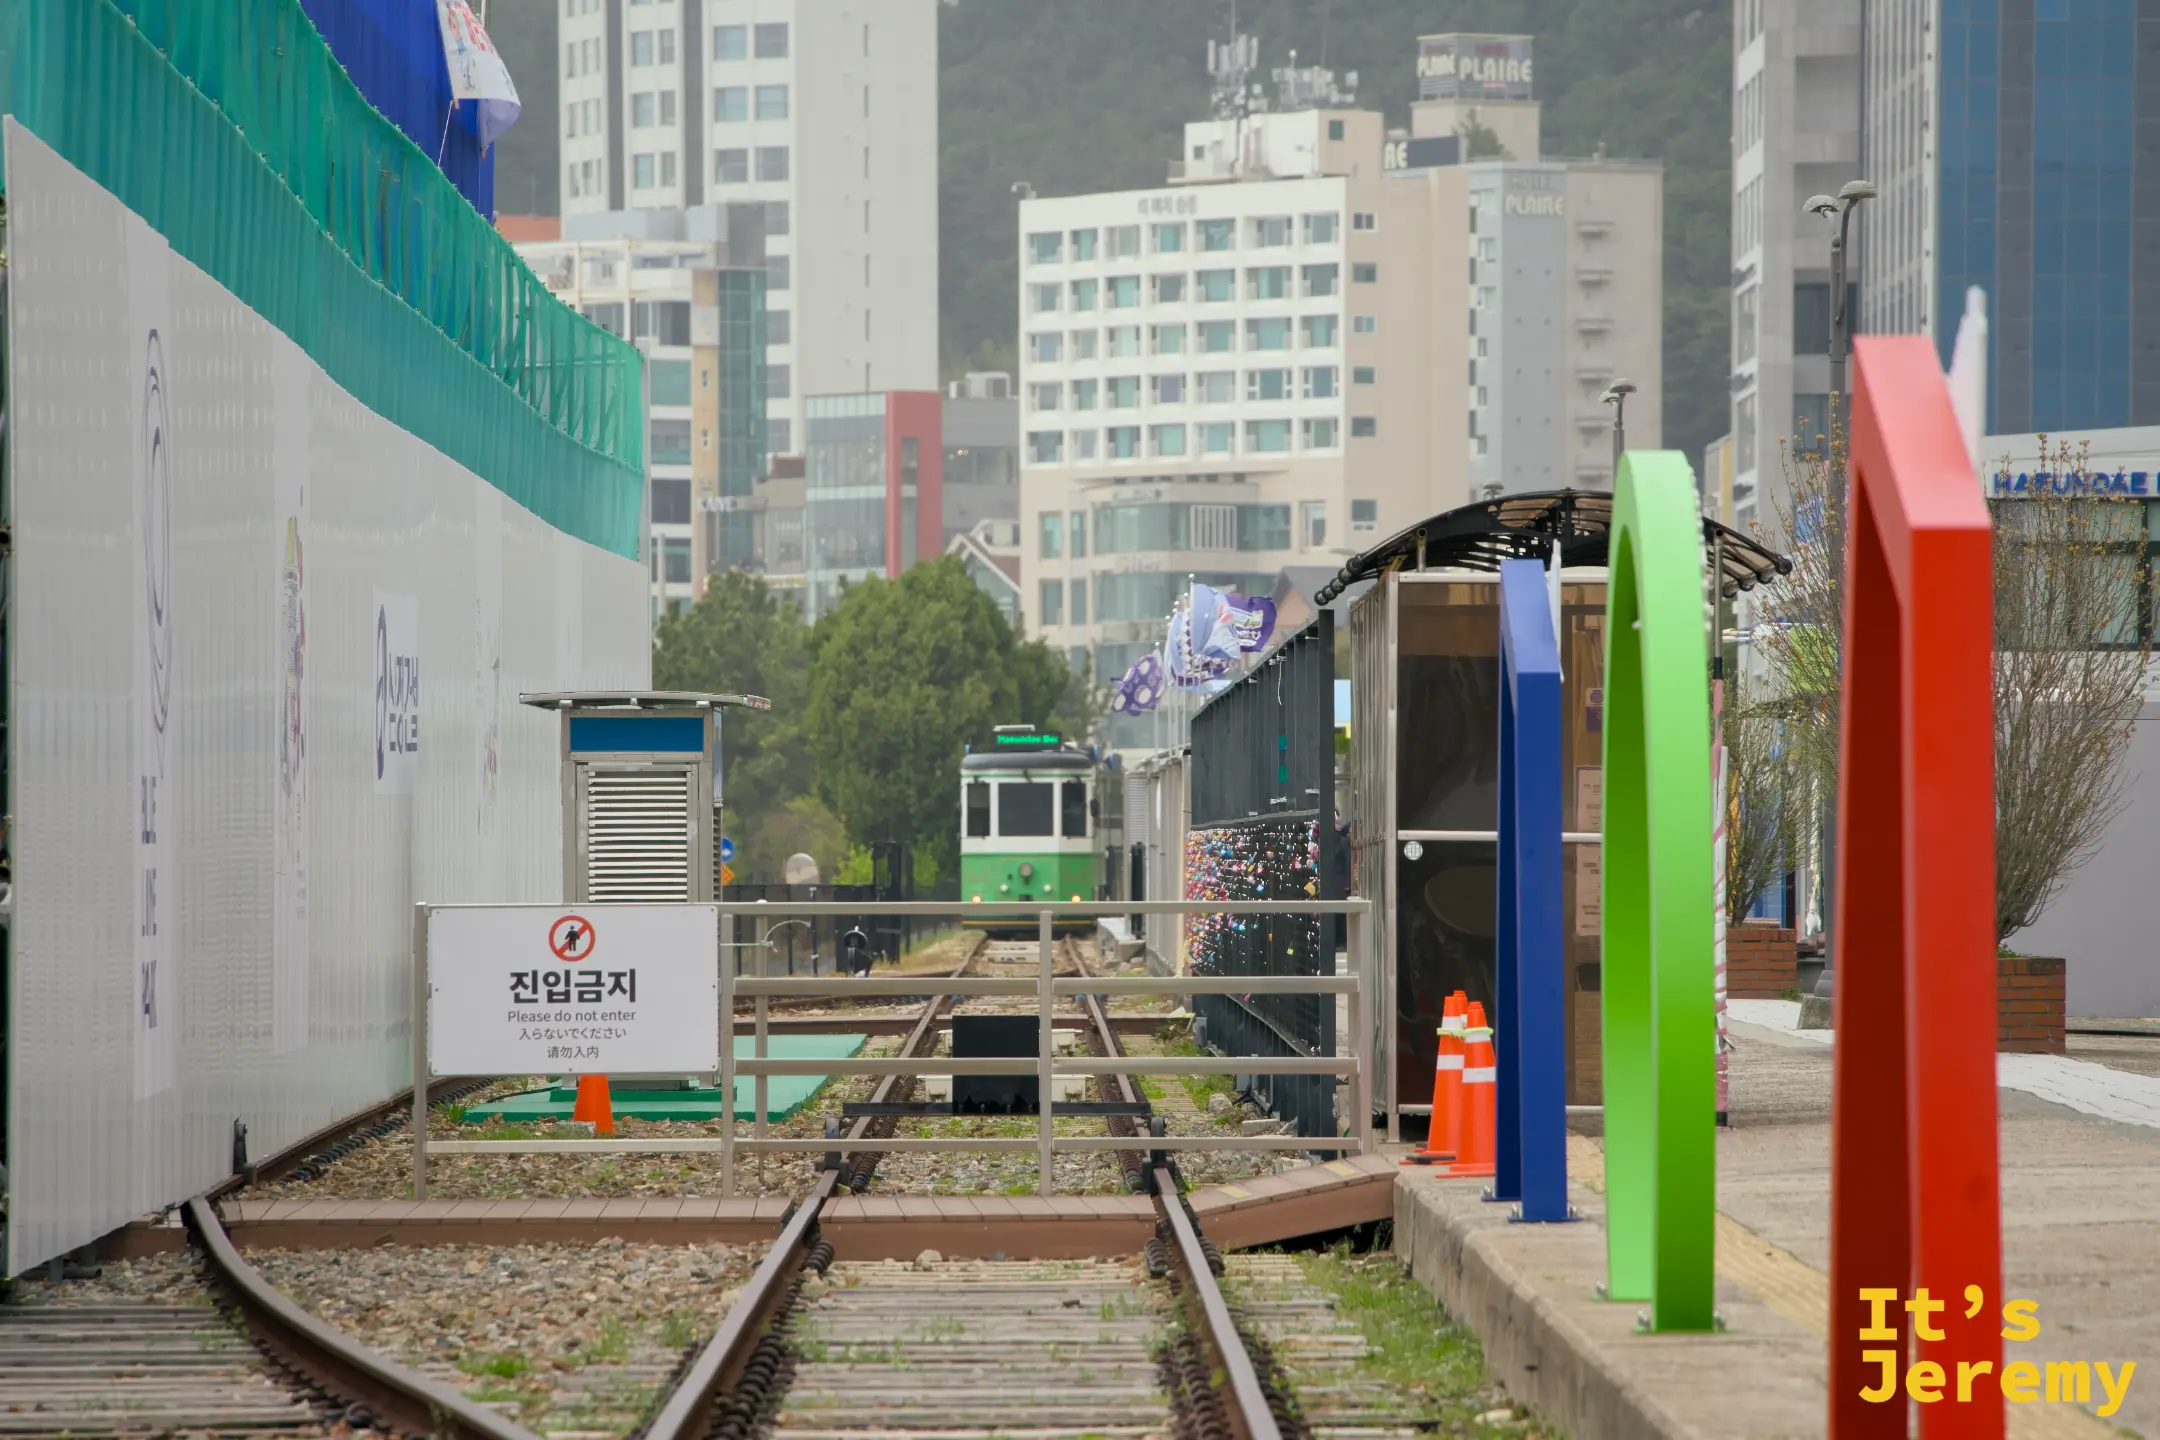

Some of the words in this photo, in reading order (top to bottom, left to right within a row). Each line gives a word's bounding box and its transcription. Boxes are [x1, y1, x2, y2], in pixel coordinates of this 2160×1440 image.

[1459, 56, 1533, 82] PLAIRE
[1505, 195, 1565, 216] PLAIRE
[509, 968, 636, 1004] 진입금지
[508, 1010, 551, 1022] Please
[554, 1010, 572, 1022] do
[575, 1010, 597, 1022] not
[600, 1010, 637, 1022] enter
[518, 1026, 627, 1041] 入らないでください
[546, 1045, 600, 1059] 请勿入内
